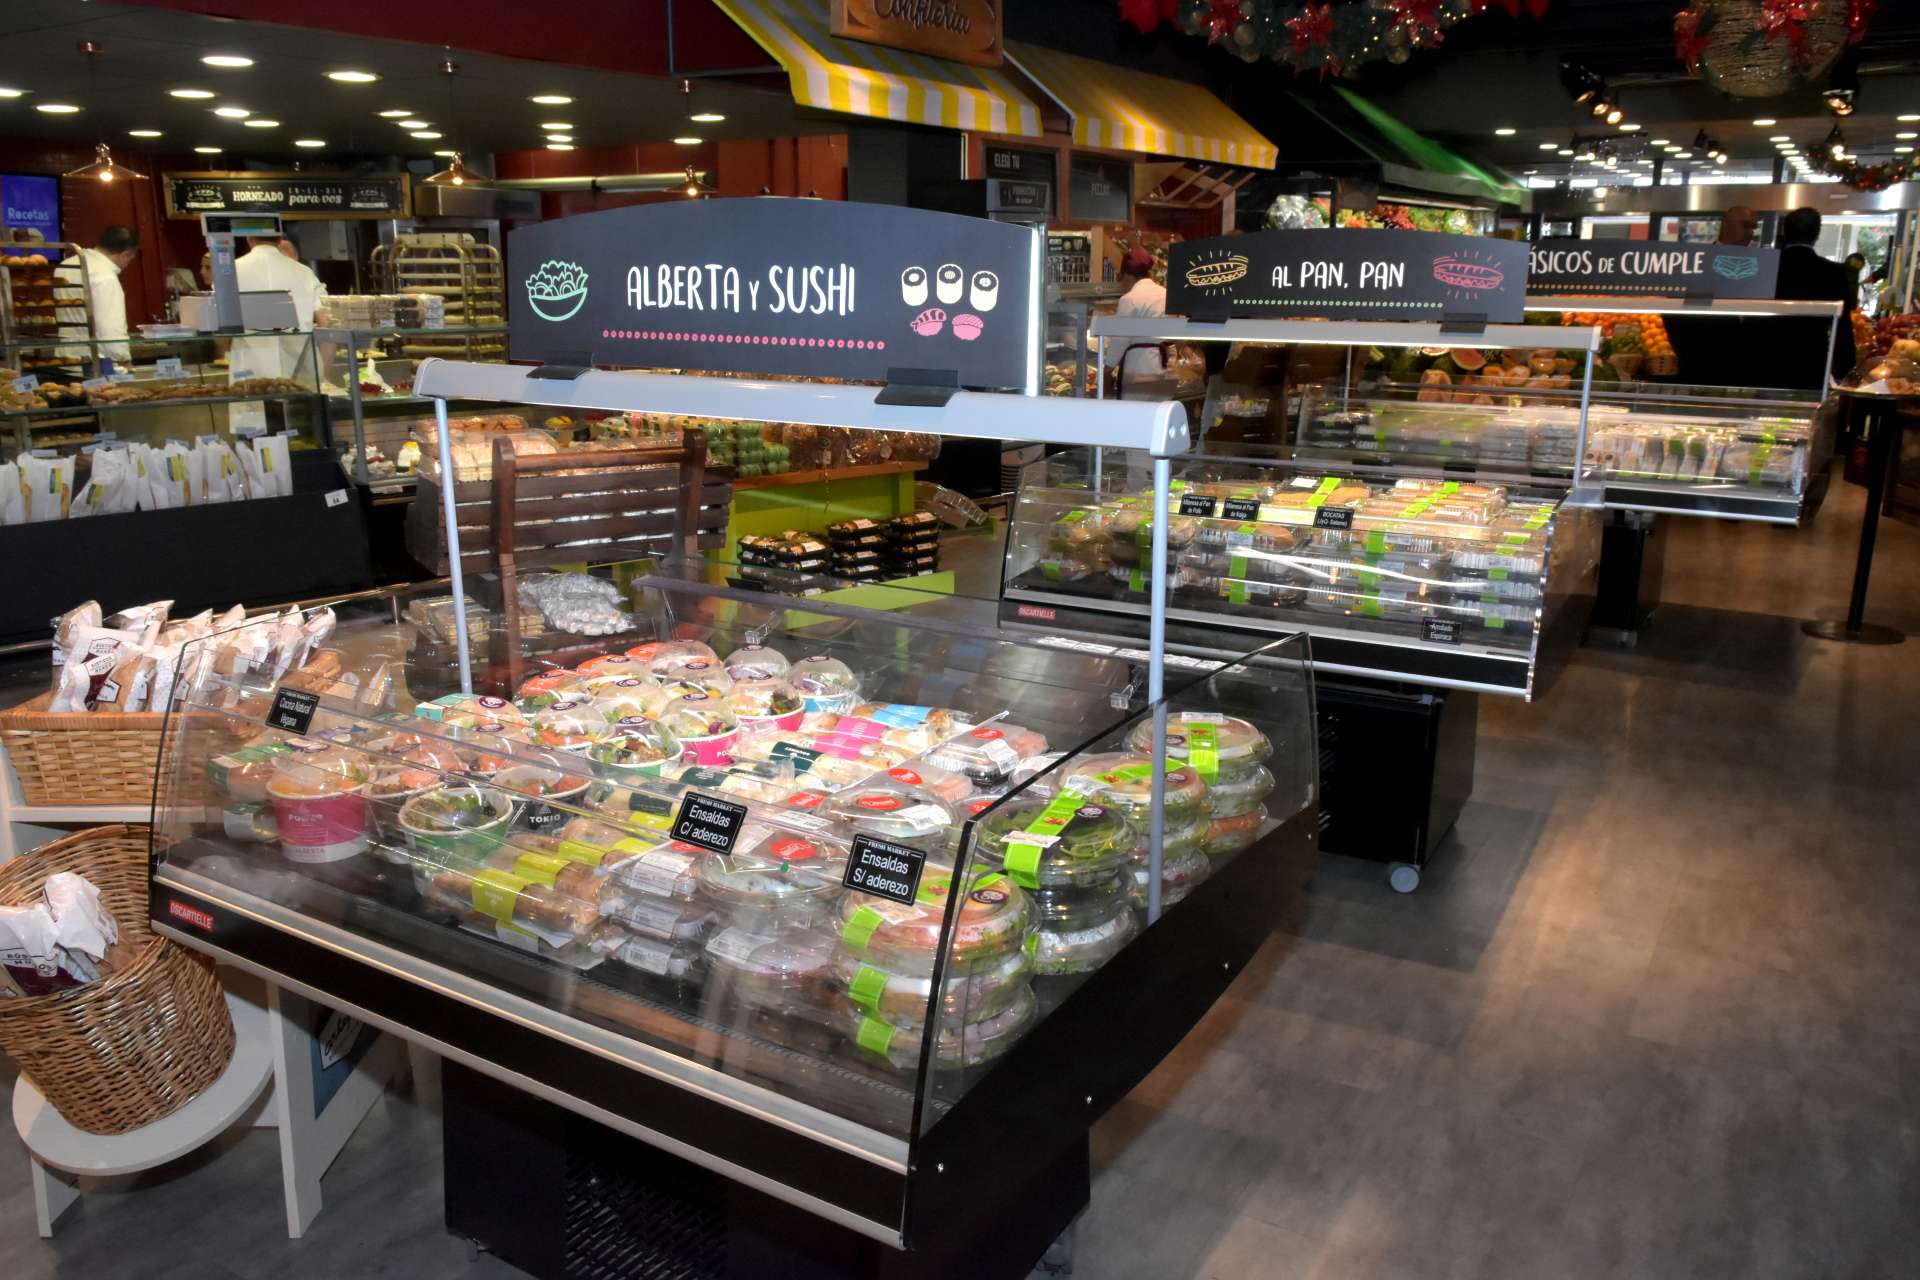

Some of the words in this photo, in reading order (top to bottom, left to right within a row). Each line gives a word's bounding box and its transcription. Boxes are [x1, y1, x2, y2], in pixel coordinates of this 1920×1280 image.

[232, 191, 284, 202] HORNEADO
[289, 194, 320, 206] para
[8, 207, 49, 221] Recetas
[1598, 257, 1615, 274] DE
[1620, 250, 1706, 276] CUMPLE
[1272, 265, 1293, 288] AL
[1300, 261, 1349, 290] PAN,
[1359, 261, 1405, 291] PAN
[626, 263, 740, 313] ALBERTA
[768, 263, 856, 316] SUSHI
[528, 814, 561, 824] TOKIO
[689, 804, 731, 828] Ensaldas
[713, 802, 733, 812] MARKET
[680, 821, 694, 835] C/
[692, 827, 728, 847] aderezo
[861, 848, 909, 875] Ensaldas
[868, 841, 886, 851] FRESH
[887, 845, 911, 857] MARKET
[853, 867, 867, 883] S/
[866, 874, 909, 896] aderezo
[169, 900, 214, 930] OSCARTIELLE
